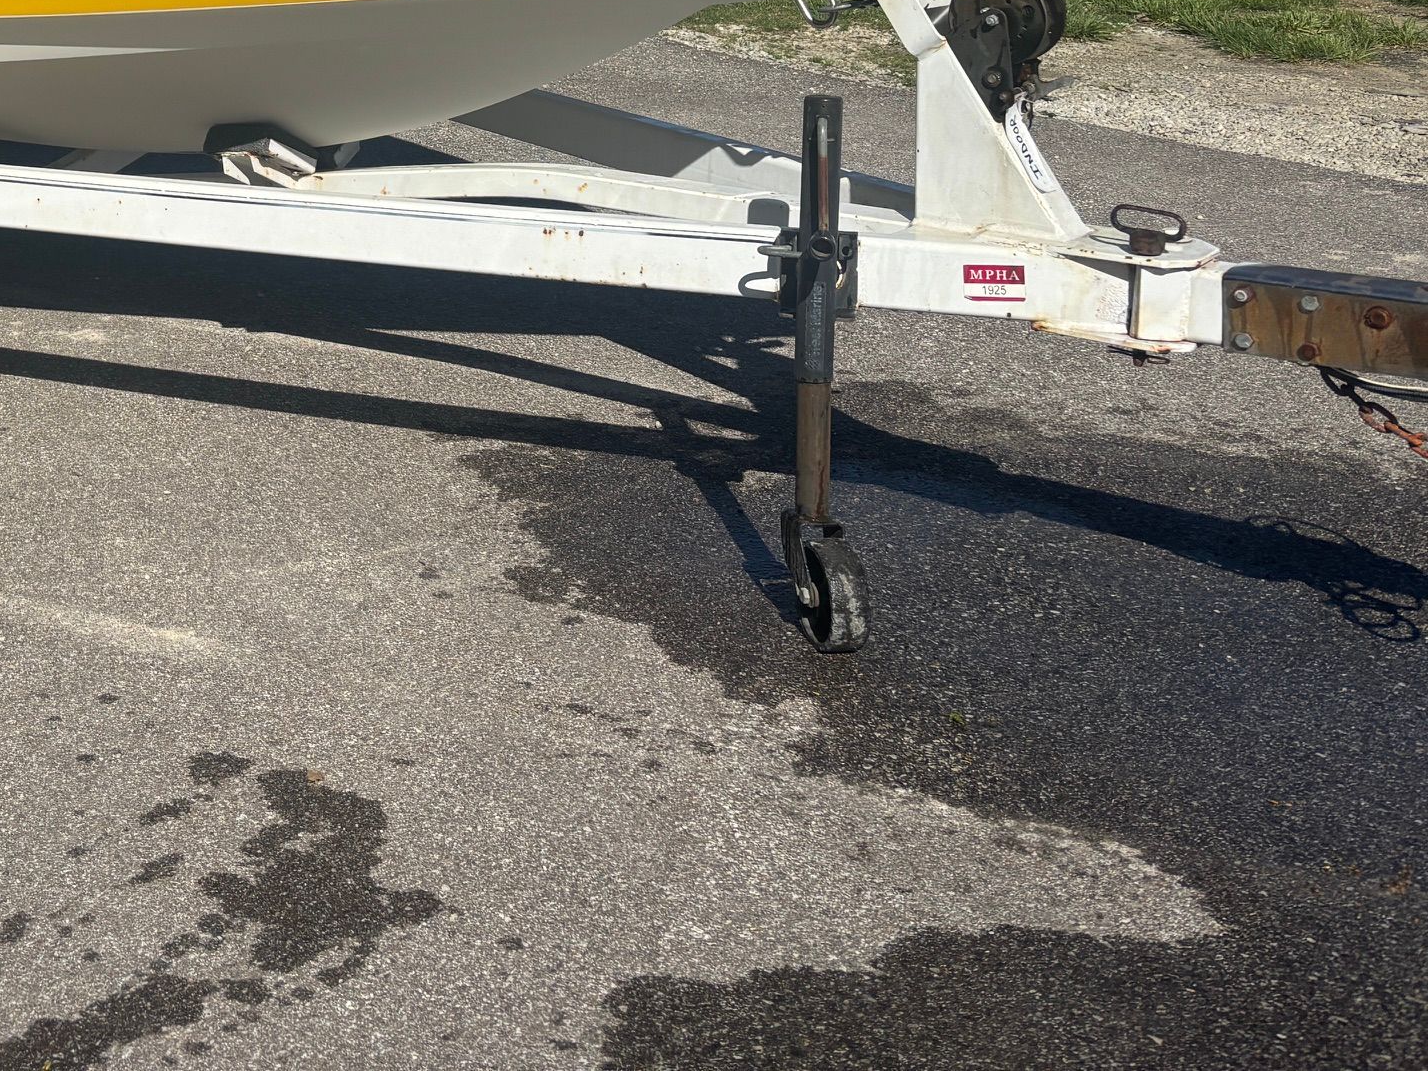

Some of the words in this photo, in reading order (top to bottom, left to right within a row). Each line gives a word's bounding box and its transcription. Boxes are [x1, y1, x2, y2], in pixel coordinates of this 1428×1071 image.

[1009, 114, 1043, 180] INDOOR
[969, 269, 1020, 281] MPHA
[982, 285, 1007, 296] 1925
